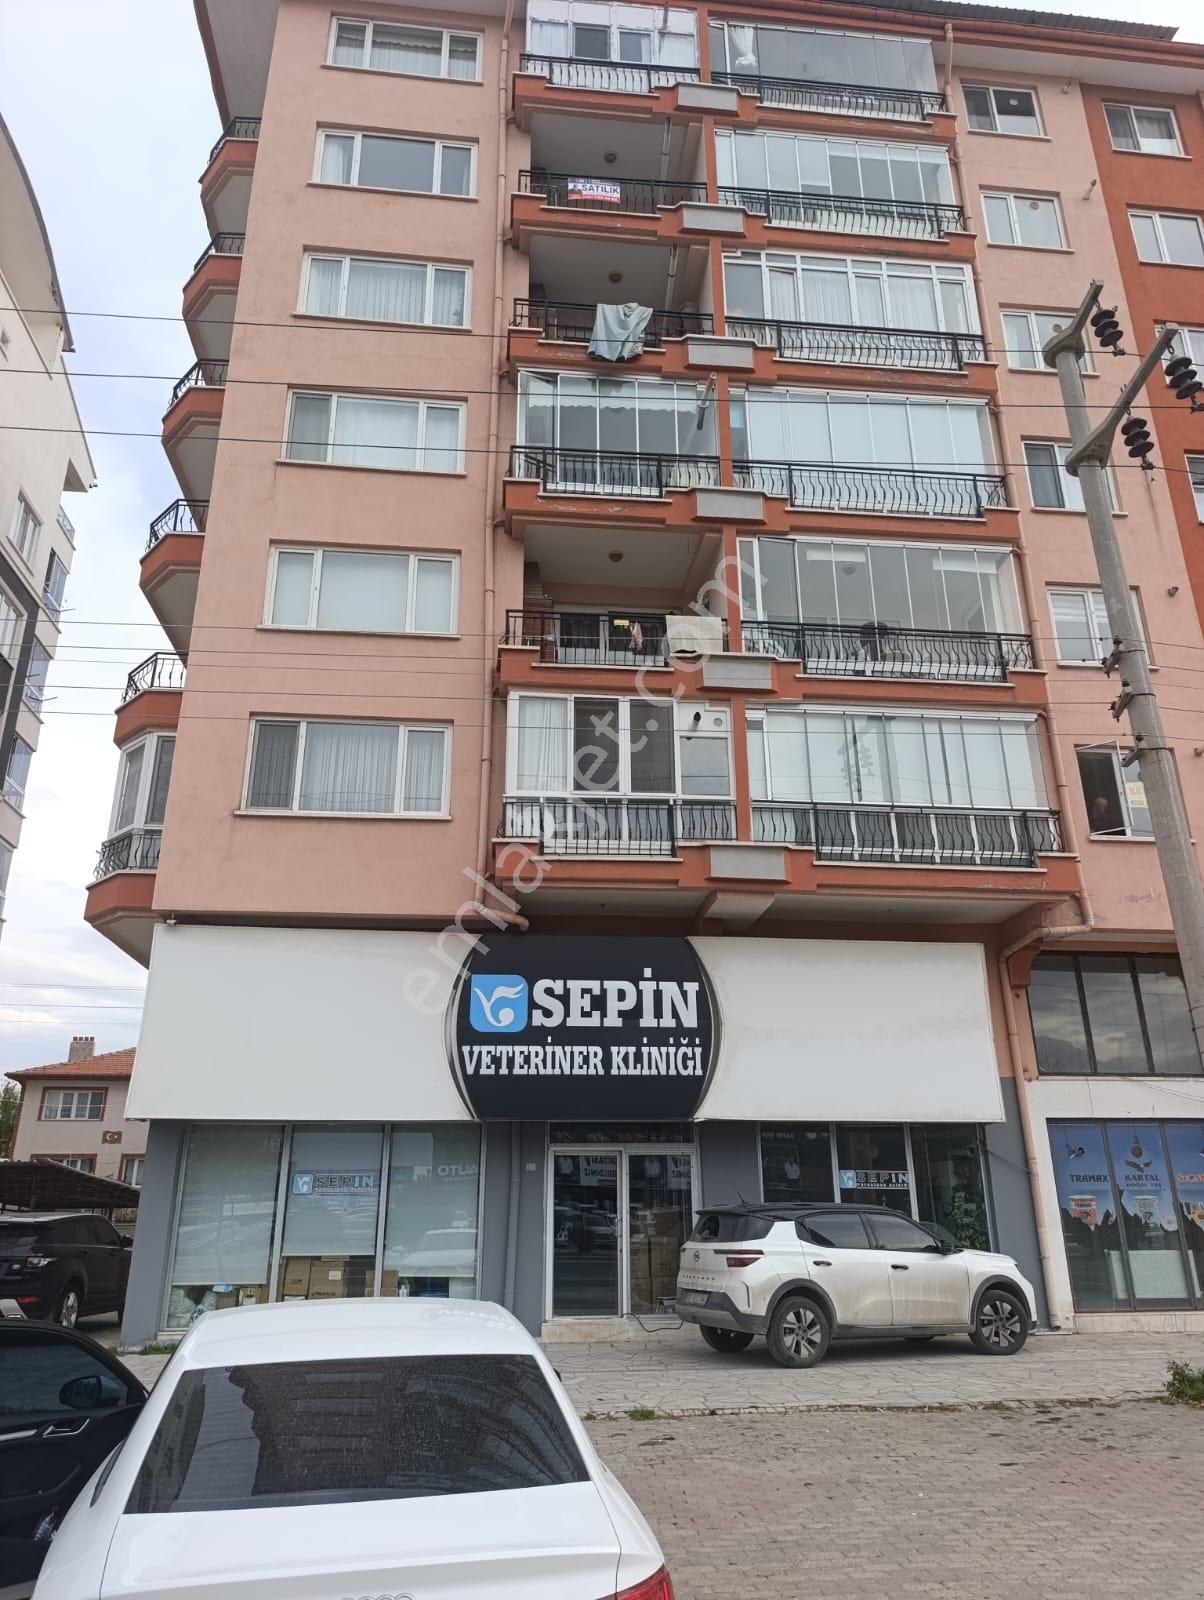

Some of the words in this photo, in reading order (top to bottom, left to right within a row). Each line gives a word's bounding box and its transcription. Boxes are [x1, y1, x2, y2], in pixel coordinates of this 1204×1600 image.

[581, 184, 619, 194] SATILIK
[532, 967, 699, 1028] SEPİN
[461, 1036, 605, 1076] VETERİNER
[610, 1036, 703, 1076] KLİNİĞİ
[1069, 1174, 1109, 1183] TRAMAX
[1124, 1173, 1160, 1181] KARTAL
